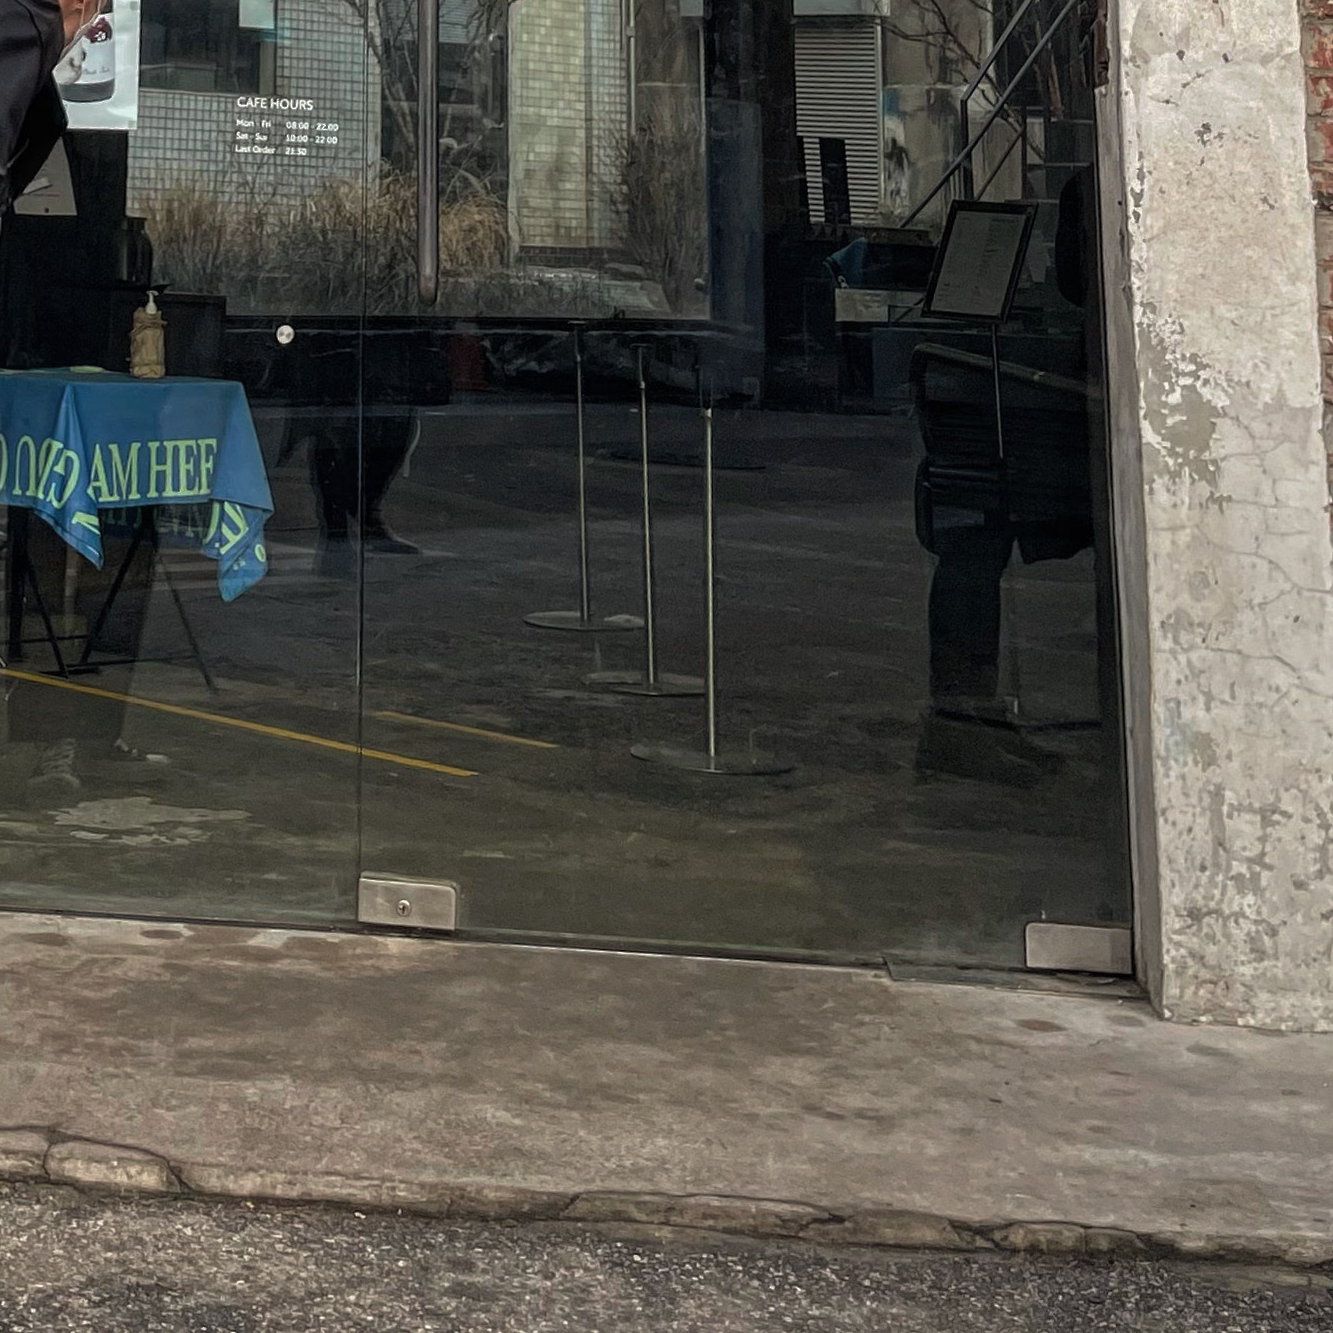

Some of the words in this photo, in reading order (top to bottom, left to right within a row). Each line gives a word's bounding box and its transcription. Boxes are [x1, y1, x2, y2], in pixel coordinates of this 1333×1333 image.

[237, 96, 268, 108] CAFE
[270, 98, 314, 110] HOURS
[236, 119, 254, 127] Mon
[261, 119, 272, 128] Fri
[236, 131, 248, 140] Sat
[235, 144, 251, 153] Last
[252, 145, 276, 154] Order
